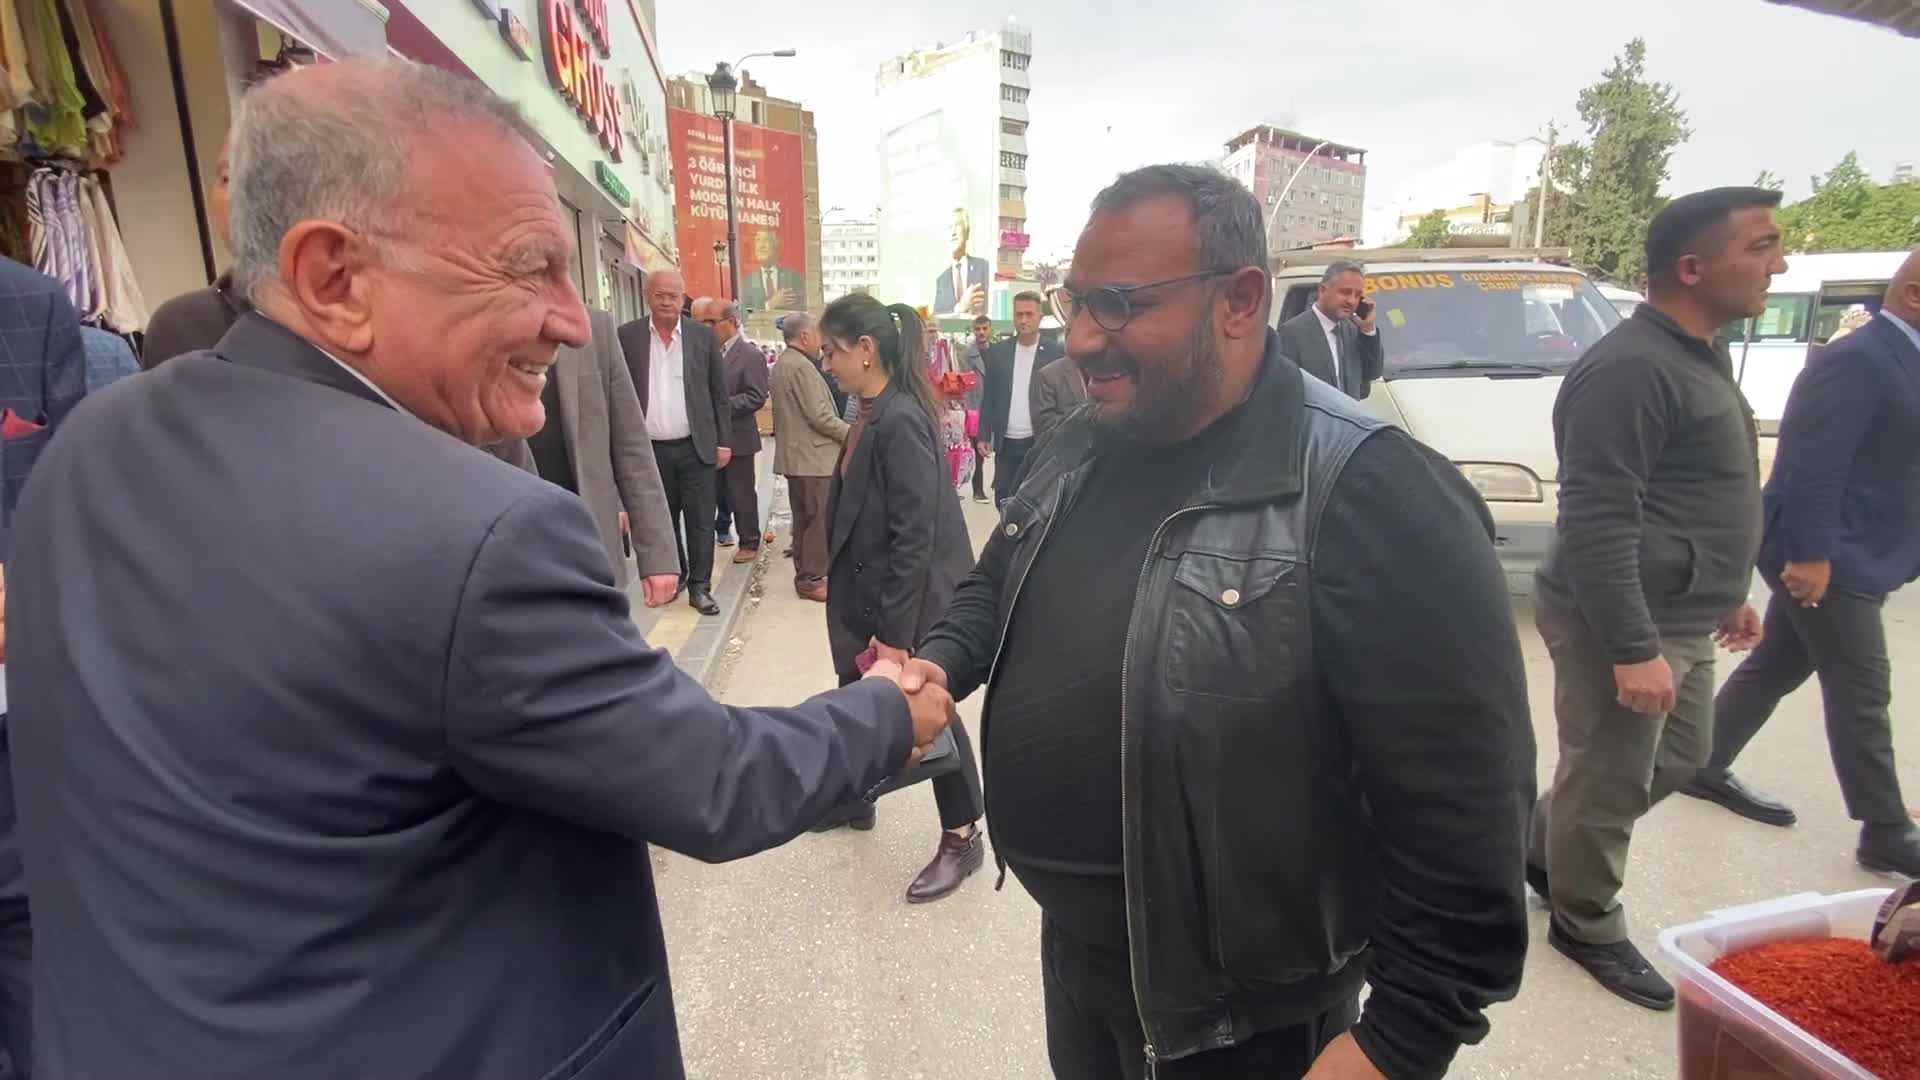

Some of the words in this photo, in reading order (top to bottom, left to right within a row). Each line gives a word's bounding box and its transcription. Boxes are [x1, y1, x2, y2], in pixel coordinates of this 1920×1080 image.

[687, 156, 697, 170] 3
[698, 155, 757, 180] ÖĞRNCİ
[689, 172, 729, 189] YURD
[737, 178, 760, 195] İLK
[689, 188, 745, 208] MODEN
[746, 197, 781, 213] HALK
[690, 203, 780, 228] KÜTÜANESİ
[1362, 272, 1454, 294] BONUS
